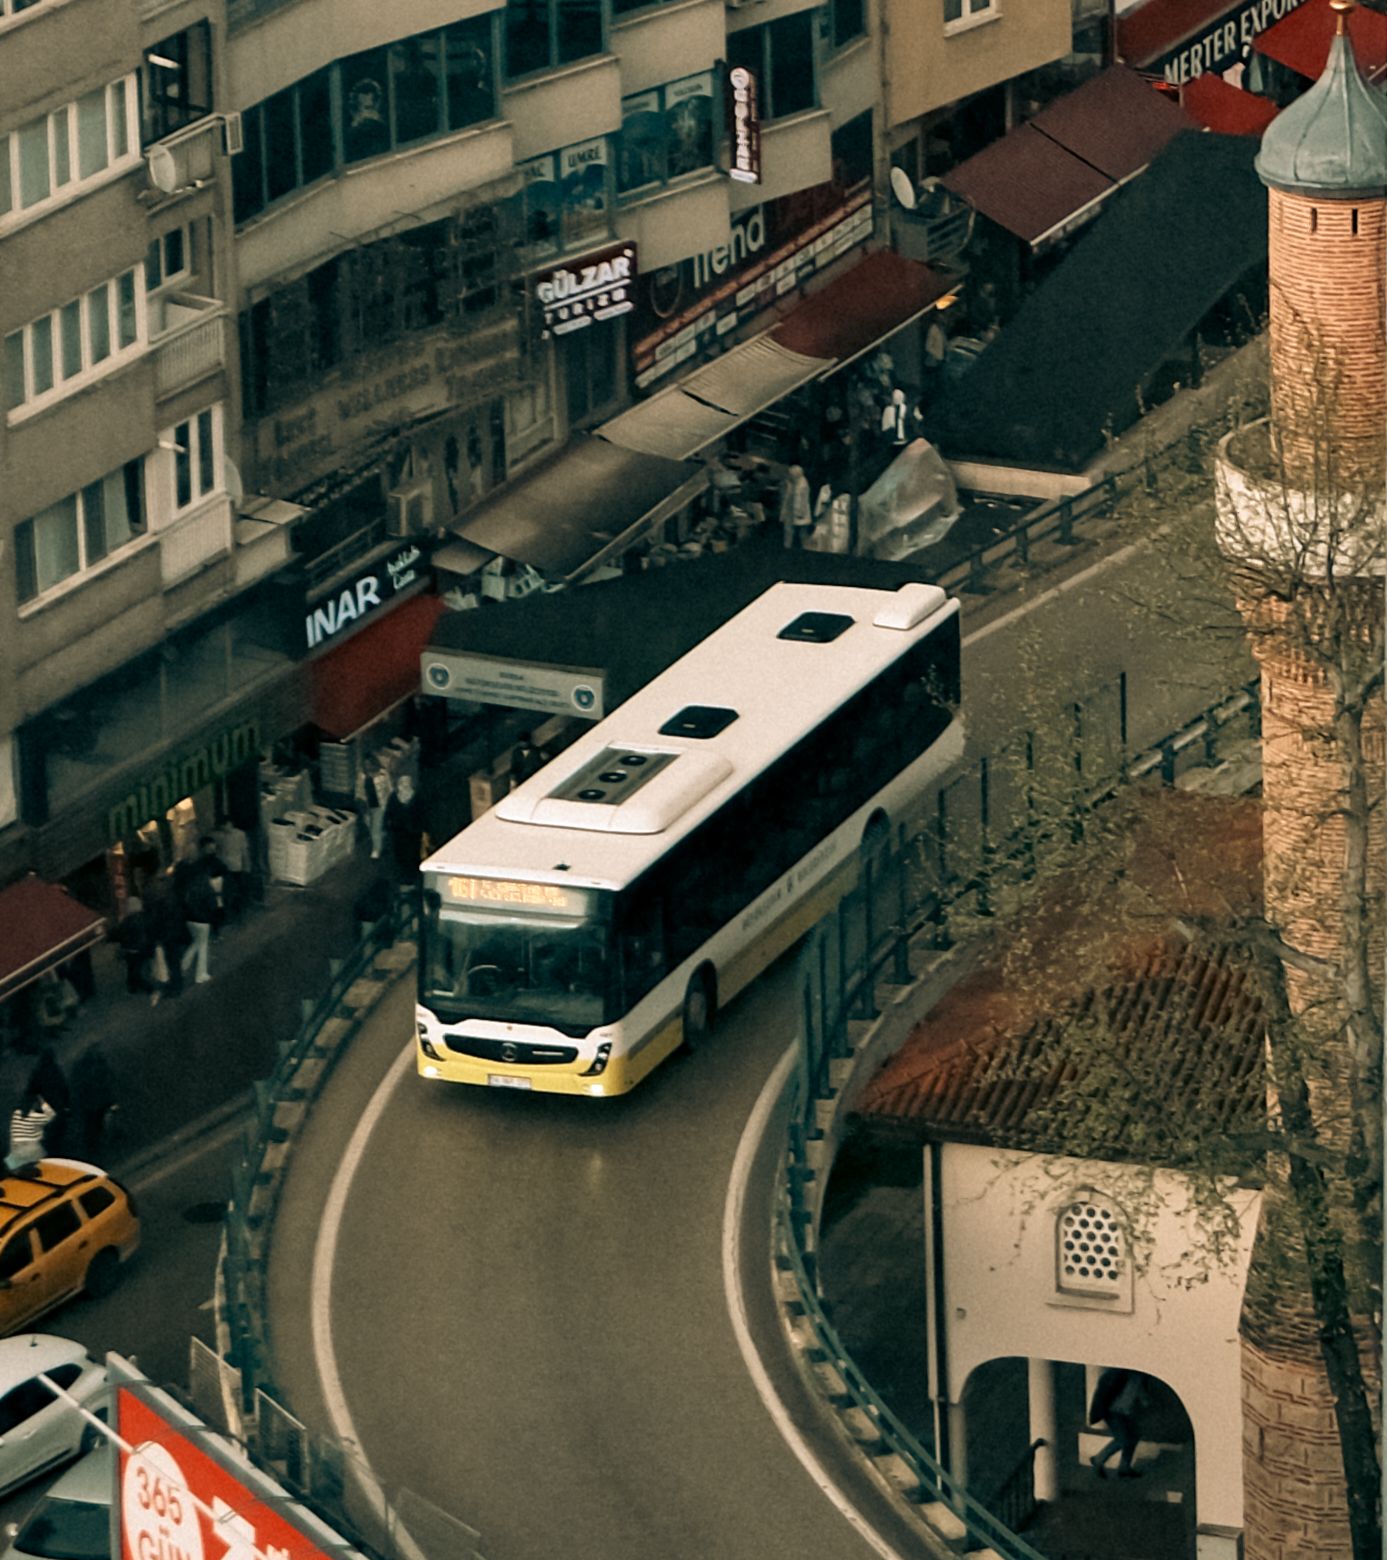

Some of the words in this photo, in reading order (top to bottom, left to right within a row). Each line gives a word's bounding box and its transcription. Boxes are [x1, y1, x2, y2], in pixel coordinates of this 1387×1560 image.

[1163, 19, 1236, 83] MERTER
[536, 254, 632, 304] GÜLZAR
[135, 1465, 183, 1527] 365
